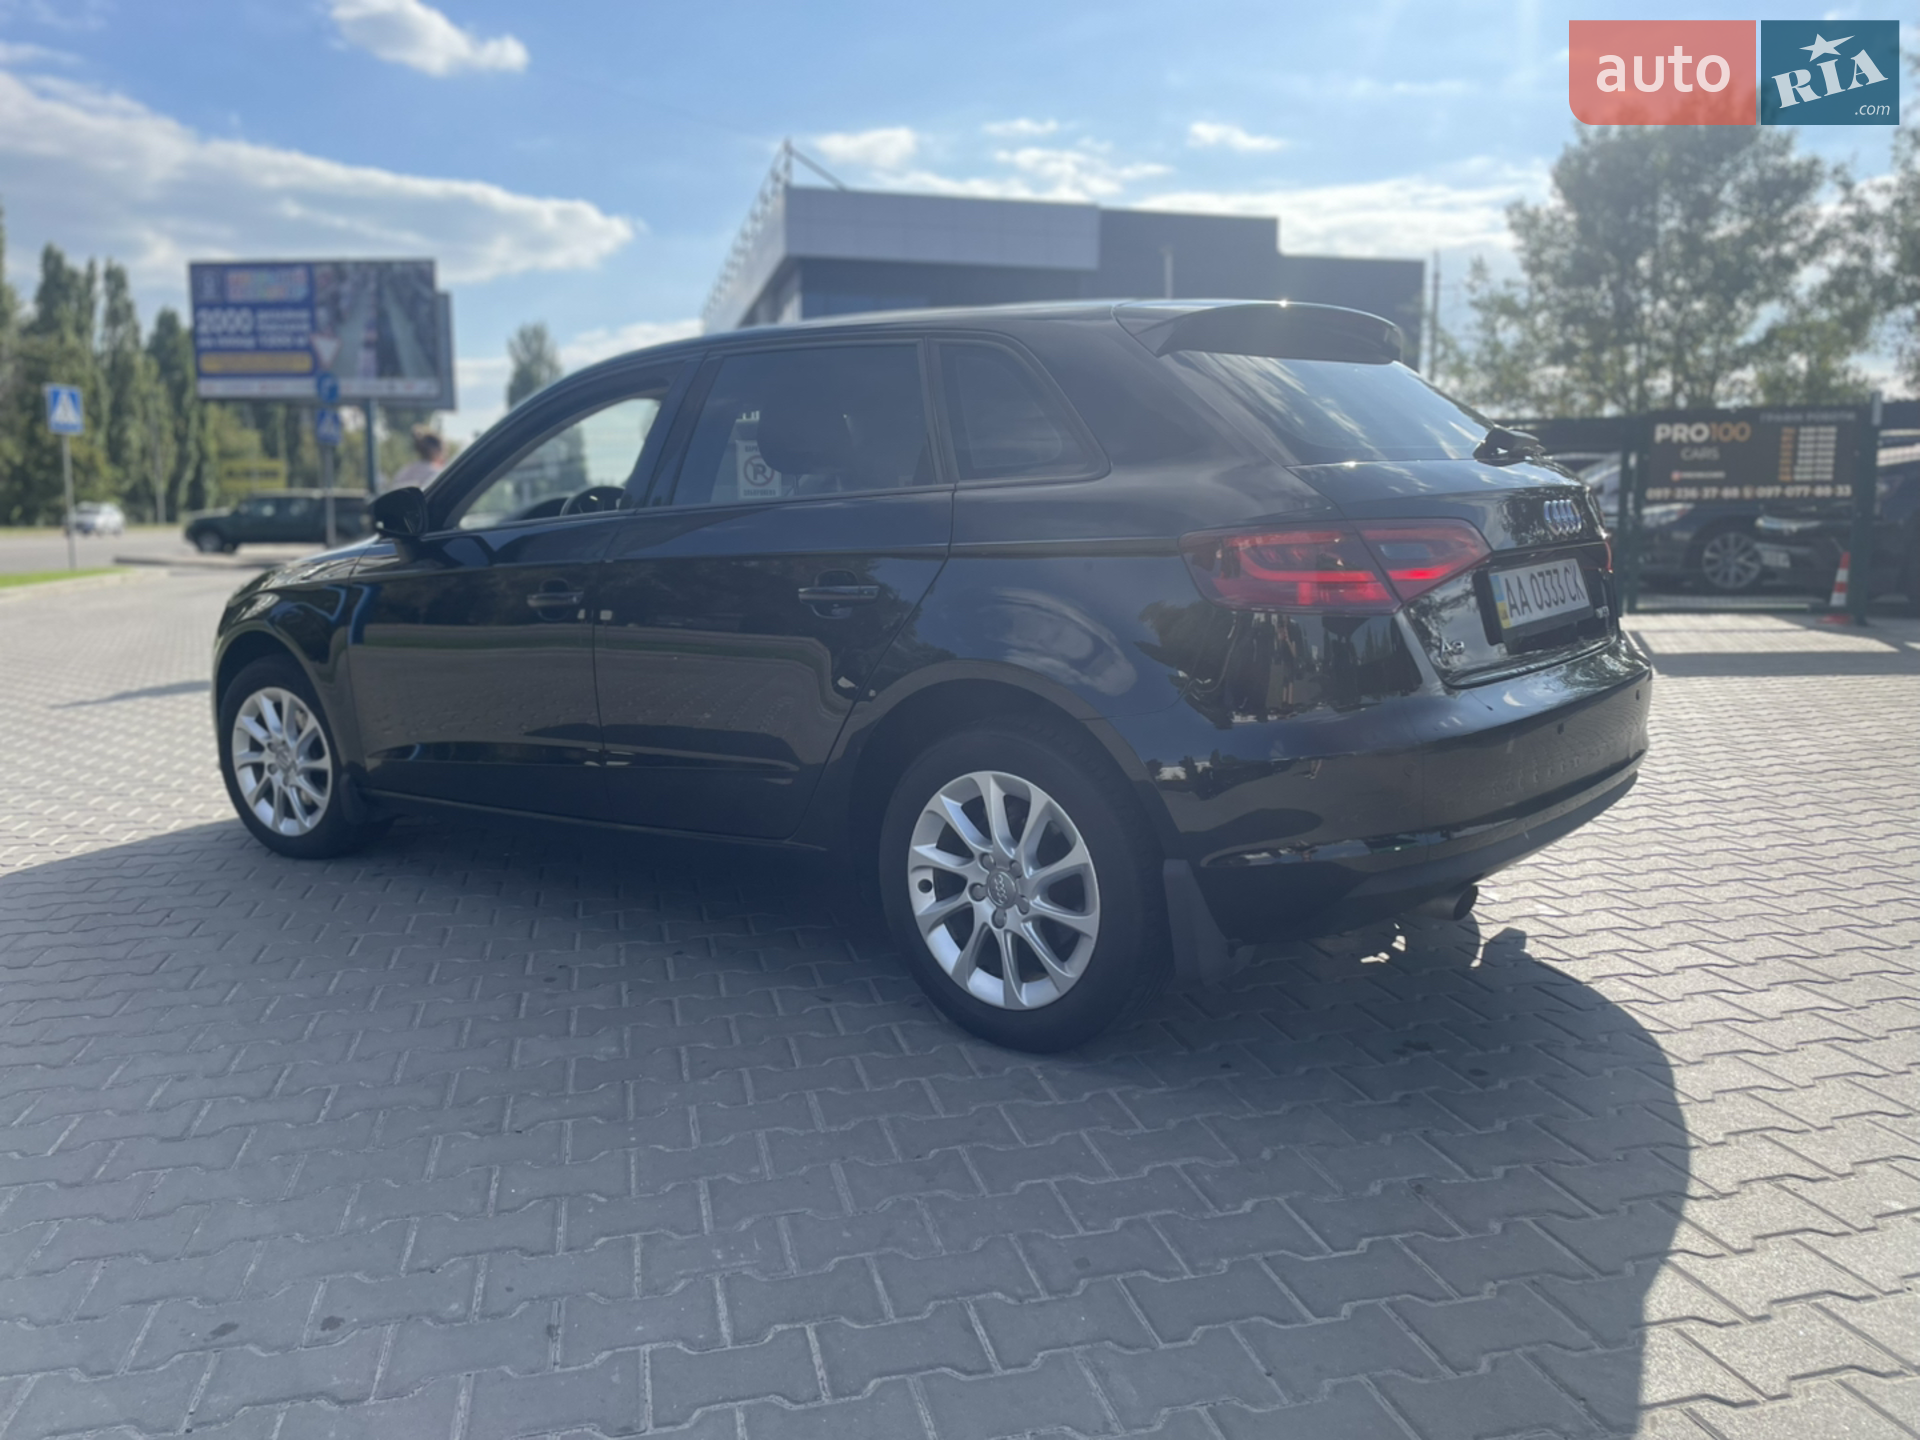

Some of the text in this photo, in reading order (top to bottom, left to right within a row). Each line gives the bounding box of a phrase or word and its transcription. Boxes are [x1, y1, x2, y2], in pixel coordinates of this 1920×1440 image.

[1654, 422, 1751, 443] PRO100
[1680, 446, 1720, 461] CARS
[1504, 575, 1533, 618] AA
[1529, 568, 1566, 611] 0333
